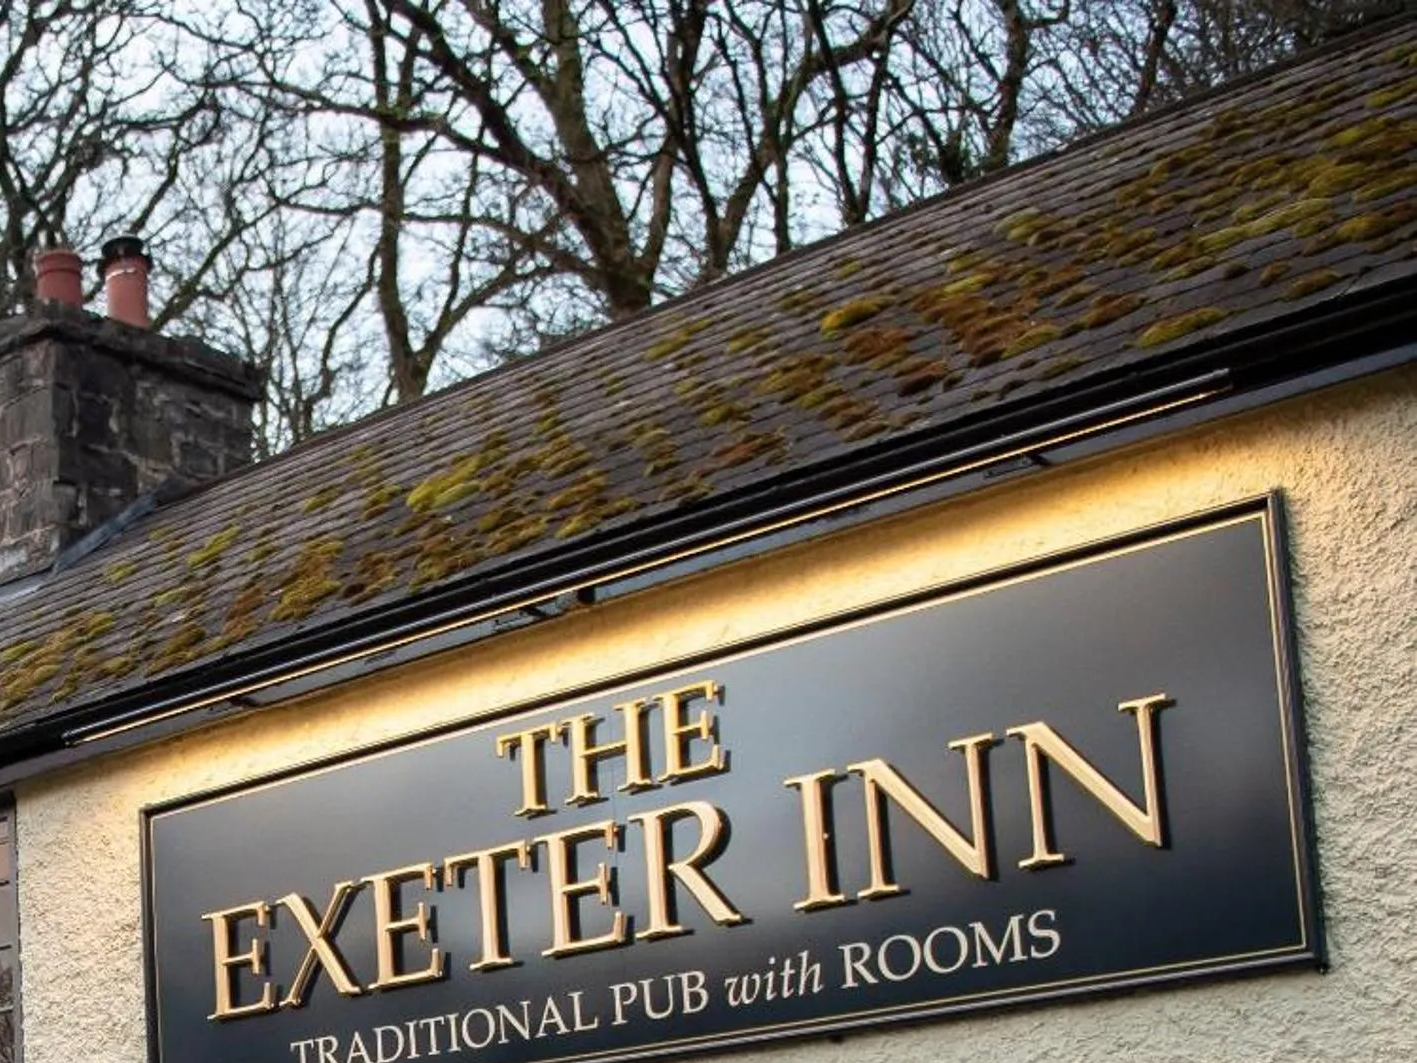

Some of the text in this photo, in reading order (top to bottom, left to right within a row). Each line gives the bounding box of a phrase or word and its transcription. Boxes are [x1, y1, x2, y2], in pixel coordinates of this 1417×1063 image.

[496, 680, 728, 818] THE
[202, 693, 1174, 1021] EXETER INN
[609, 970, 709, 1025] PUB
[724, 953, 824, 1007] with
[838, 909, 1062, 988] ROOMS
